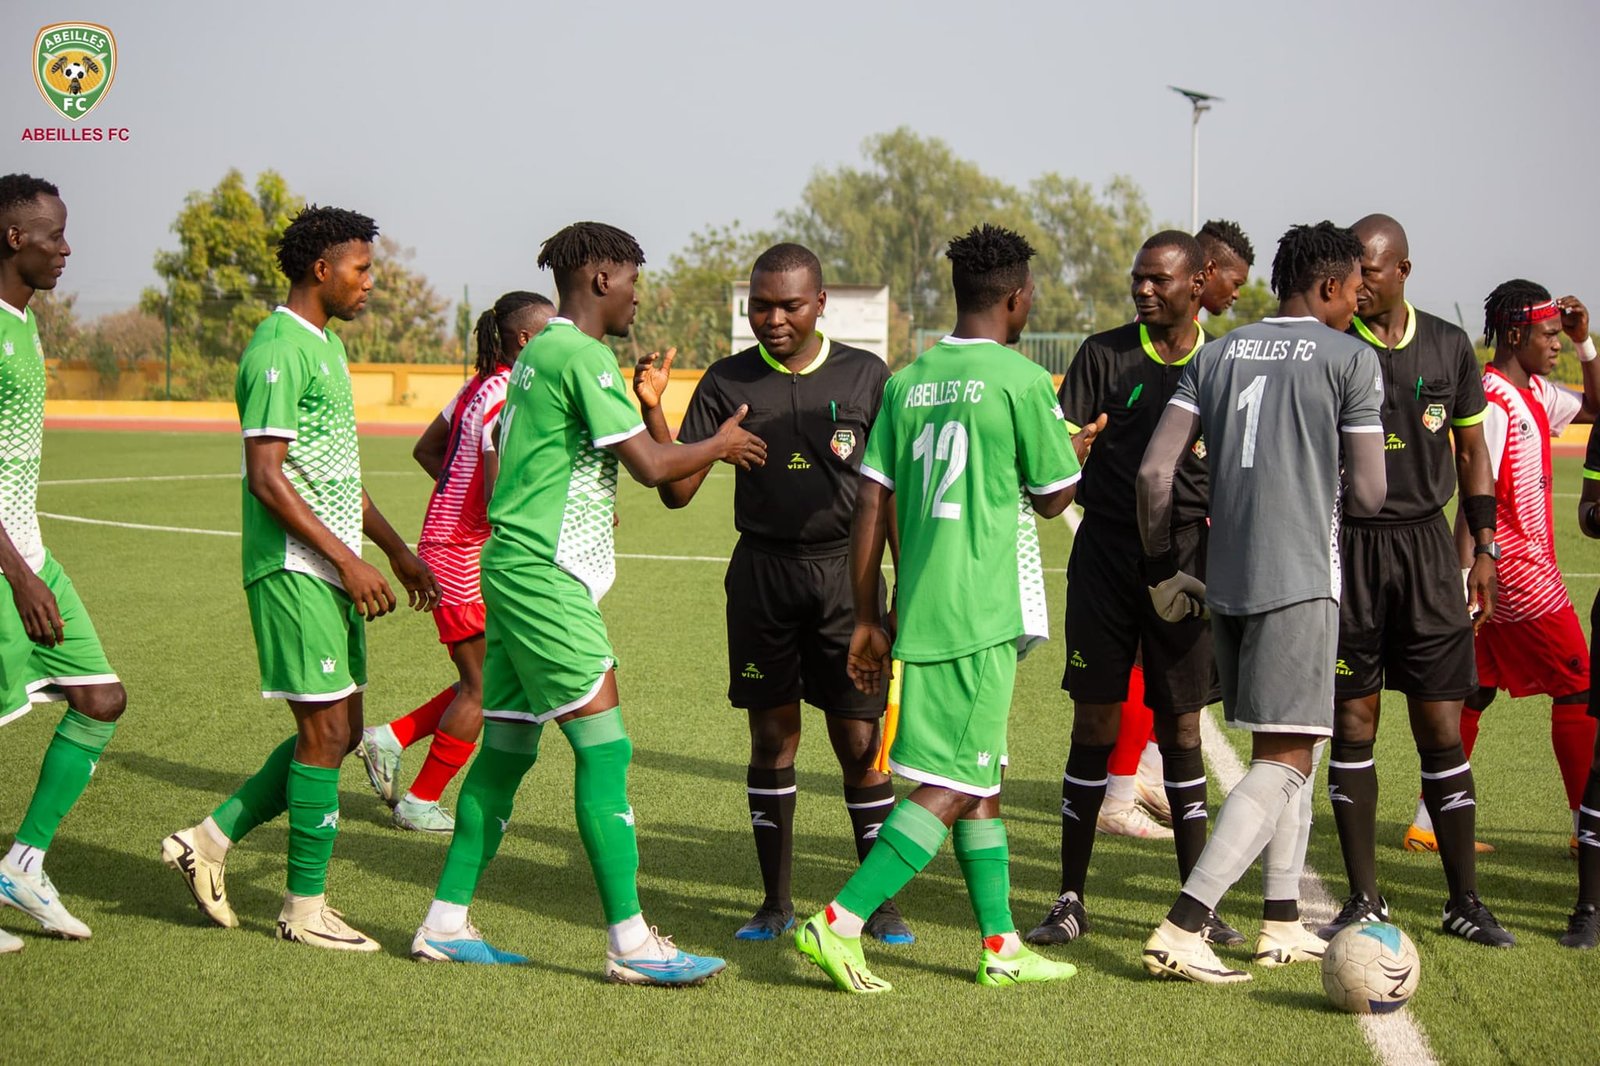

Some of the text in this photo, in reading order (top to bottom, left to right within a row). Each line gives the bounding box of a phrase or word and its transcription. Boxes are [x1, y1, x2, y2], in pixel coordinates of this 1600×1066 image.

[1225, 339, 1317, 361] ABEILLES FC
[518, 364, 535, 390] FC
[905, 380, 985, 408] ABEILLES FC
[1237, 375, 1267, 468] 1
[912, 420, 969, 521] 12
[1335, 668, 1354, 676] izir
